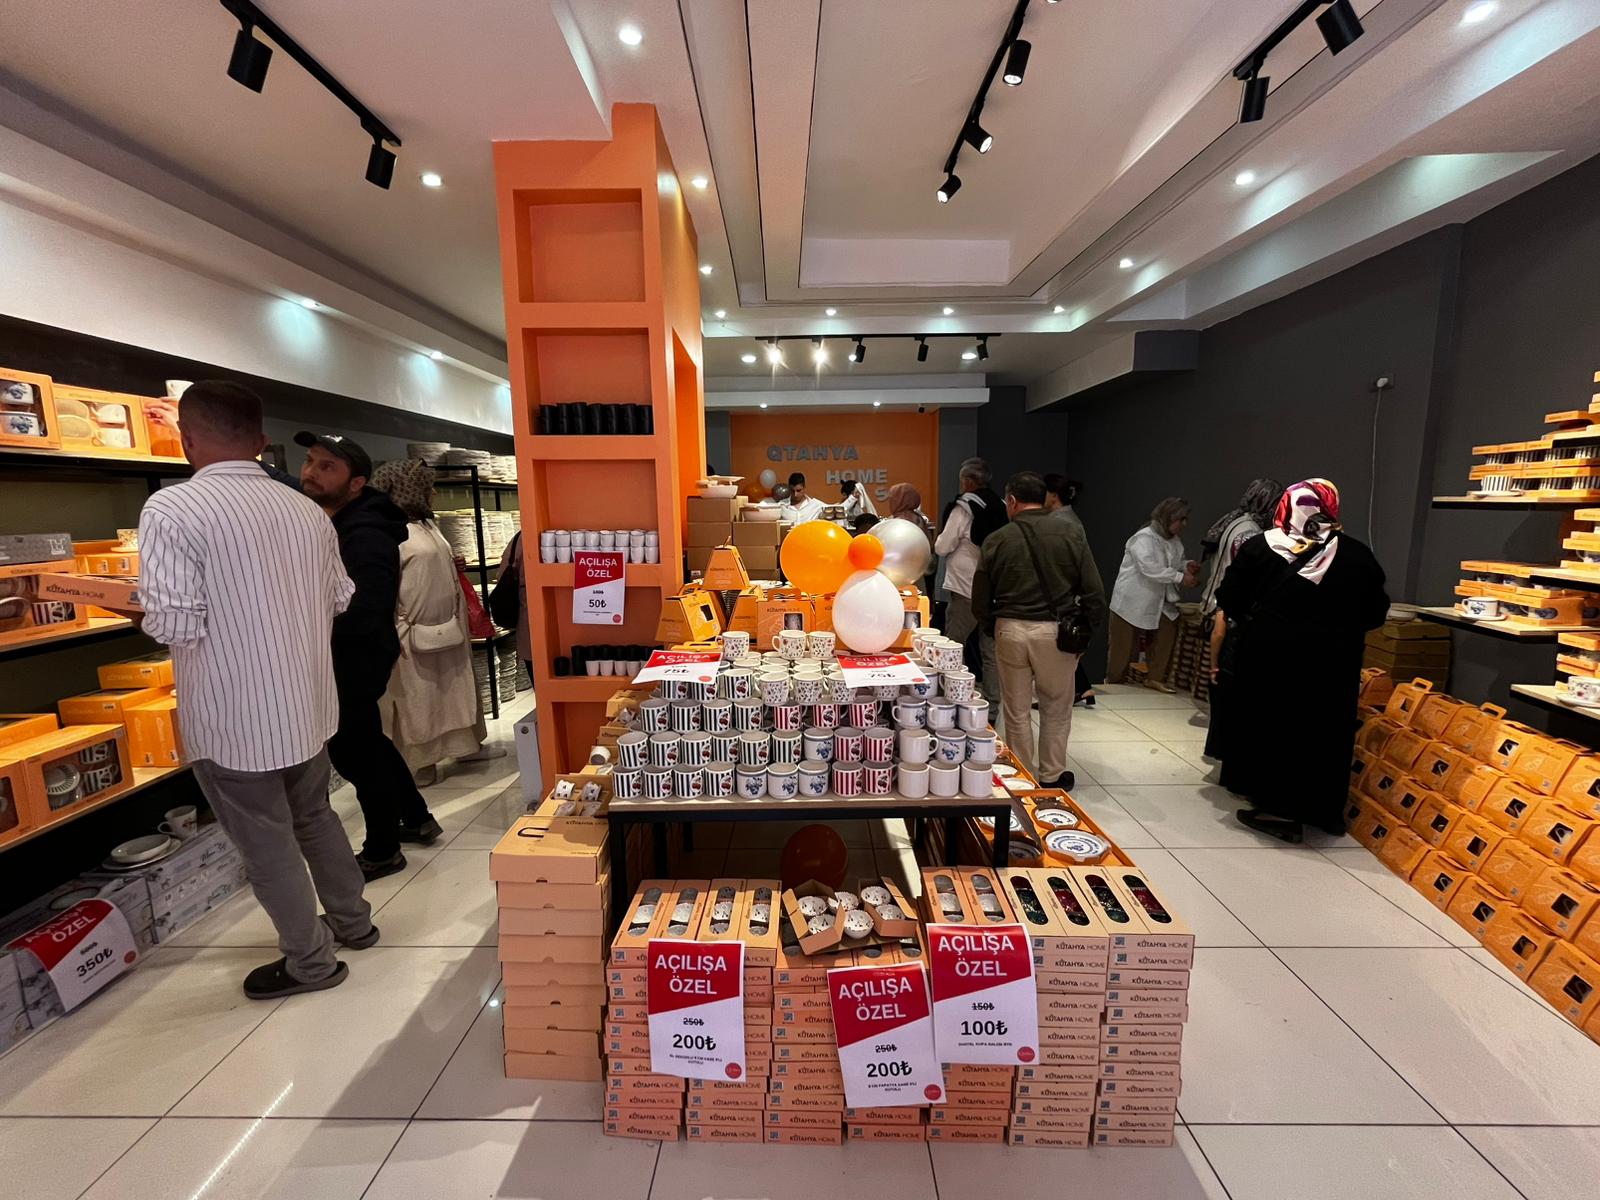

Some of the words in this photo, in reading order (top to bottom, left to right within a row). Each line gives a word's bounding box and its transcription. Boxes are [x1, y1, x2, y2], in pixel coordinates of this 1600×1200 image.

[826, 469, 888, 484] HOME
[579, 557, 617, 568] AÇILIŞA
[586, 568, 612, 578] ÖZEL
[589, 599, 606, 608] 50₺
[52, 915, 97, 942] ÖZEL
[938, 935, 1015, 956] AÇILIŞA
[76, 947, 113, 977] 350₺
[655, 954, 727, 975] AÇILIŞA
[955, 958, 1007, 977] ÖZEL
[669, 975, 717, 995] ÖZEL
[838, 976, 913, 1002] AÇILIŞA
[856, 1003, 906, 1021] ÖZEL
[960, 1020, 1008, 1036] 100₺
[672, 1033, 716, 1051] 200₺
[866, 1060, 912, 1078] 200₺
